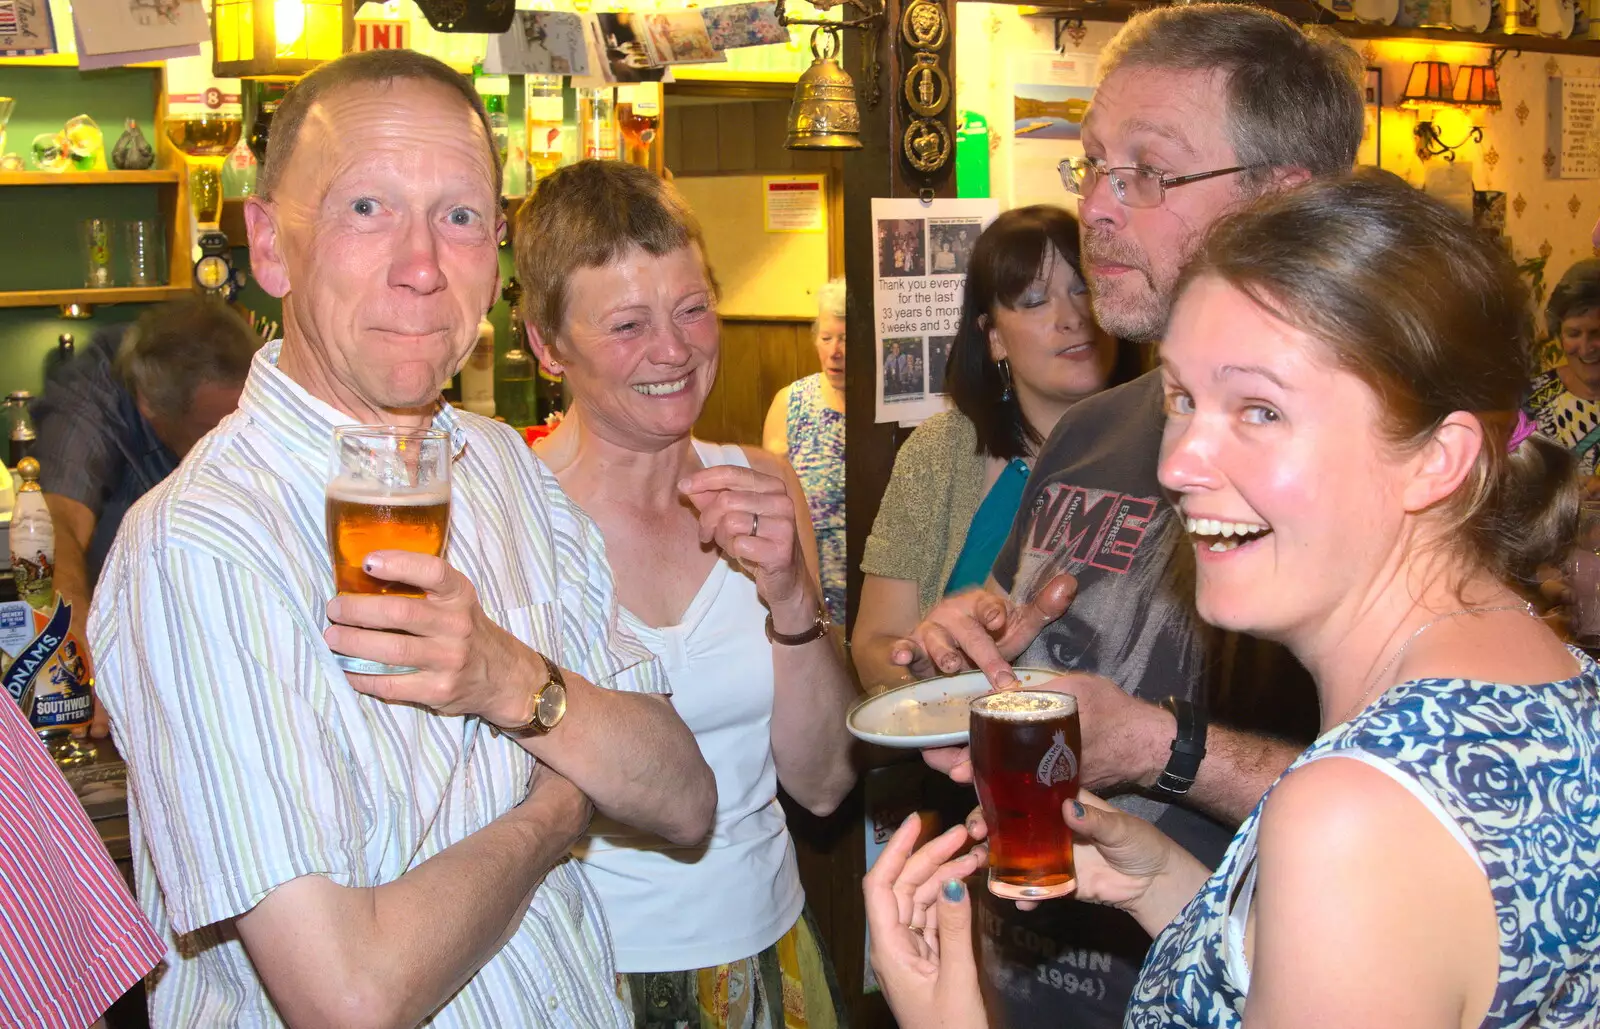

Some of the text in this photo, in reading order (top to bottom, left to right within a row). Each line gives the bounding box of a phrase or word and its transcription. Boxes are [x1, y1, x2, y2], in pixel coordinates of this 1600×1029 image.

[207, 92, 220, 105] 8
[879, 279, 905, 291] Thank
[908, 280, 927, 292] you
[898, 292, 954, 304] for the last
[882, 308, 893, 320] 33
[895, 308, 923, 321] years
[925, 305, 933, 317] 6
[881, 322, 887, 334] 3
[887, 321, 918, 333] weeks
[920, 320, 940, 331] and
[943, 319, 951, 331] 3
[1050, 495, 1082, 545] MUSICAL
[1030, 483, 1158, 574] NME
[1101, 504, 1130, 555] EXPRESS
[36, 695, 90, 715] SOUTHWOLD
[55, 710, 85, 722] BITTER
[1040, 743, 1062, 778] ADNAMS
